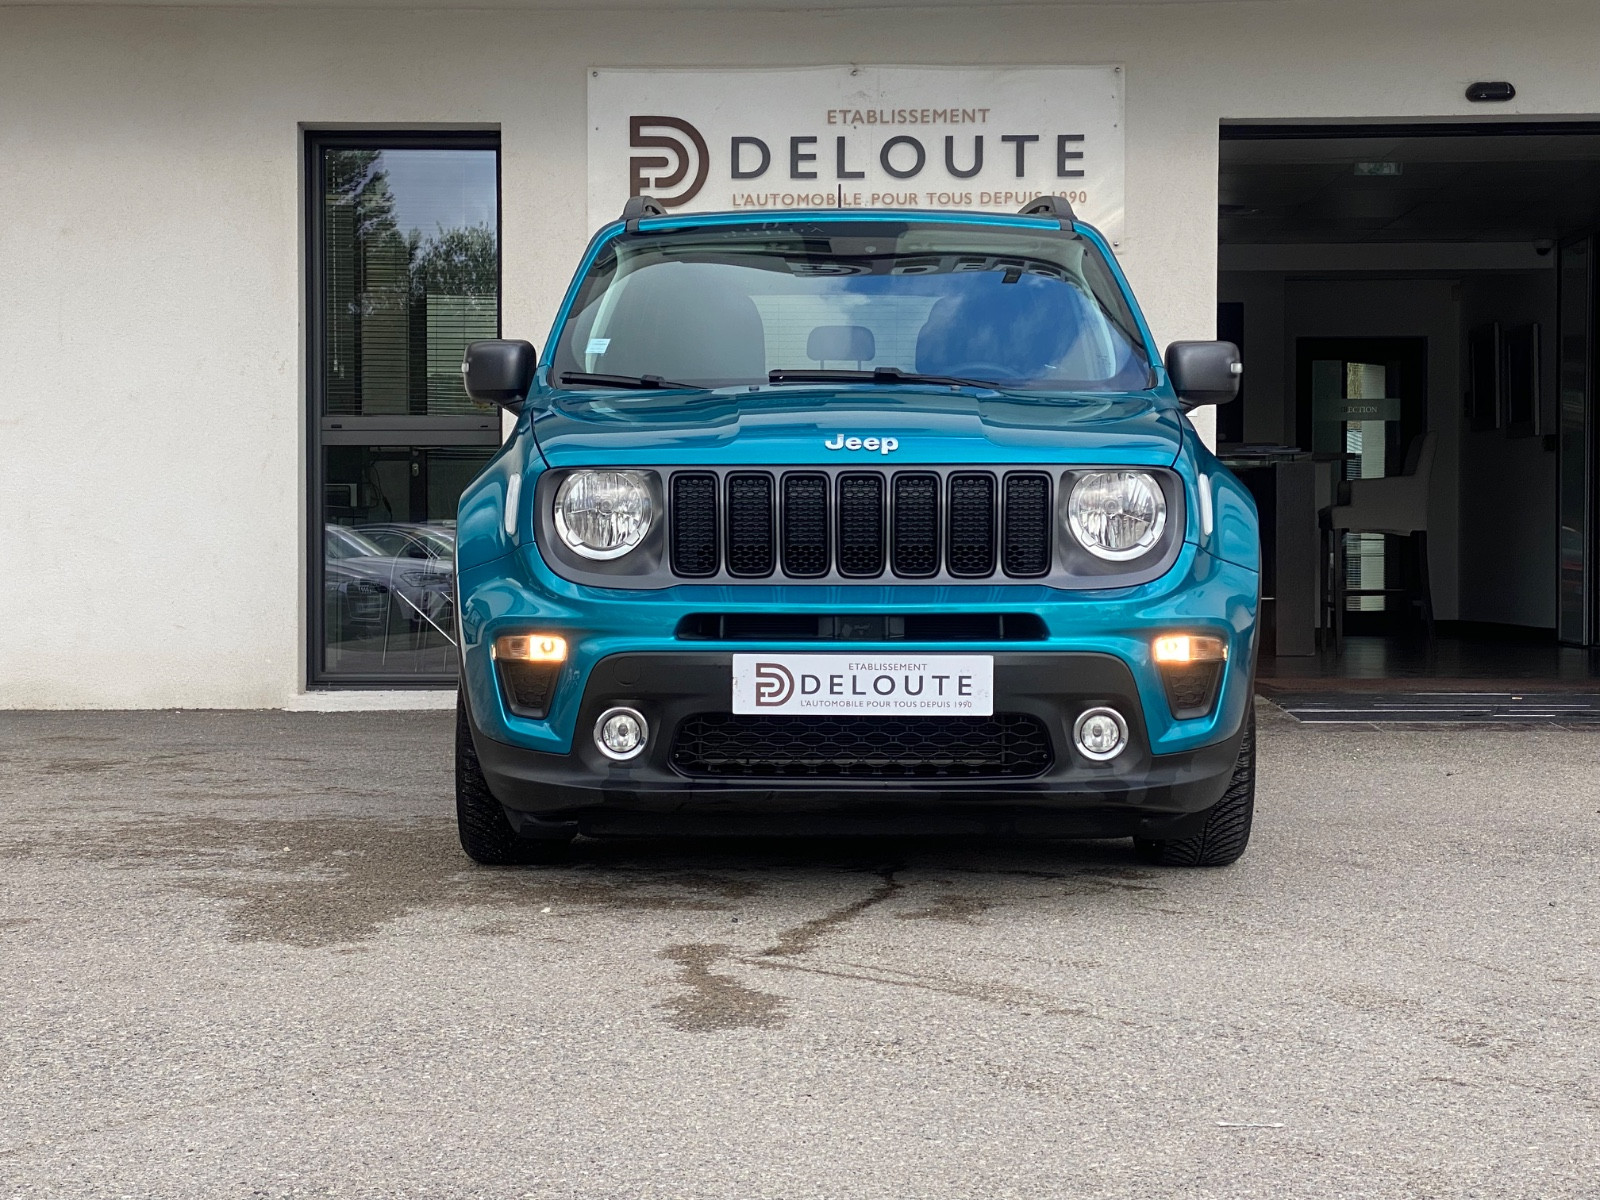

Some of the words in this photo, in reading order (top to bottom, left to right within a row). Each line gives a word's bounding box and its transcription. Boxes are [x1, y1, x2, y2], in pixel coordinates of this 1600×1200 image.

[827, 108, 990, 125] ETABLISSEMENT
[730, 133, 1085, 180] DELOUTE
[732, 193, 862, 207] L'AUTOMOBLE
[871, 192, 919, 206] POUR
[926, 192, 973, 205] TOUS
[824, 434, 899, 454] Jeep
[848, 662, 928, 672] ETABLISSEMENT
[800, 674, 973, 697] DELOUTE
[800, 700, 864, 708] L'AUTOMOBILE
[866, 700, 891, 708] POUR
[893, 700, 918, 708] TOUS
[919, 700, 951, 709] DEPUIS
[954, 700, 973, 709] 1990
